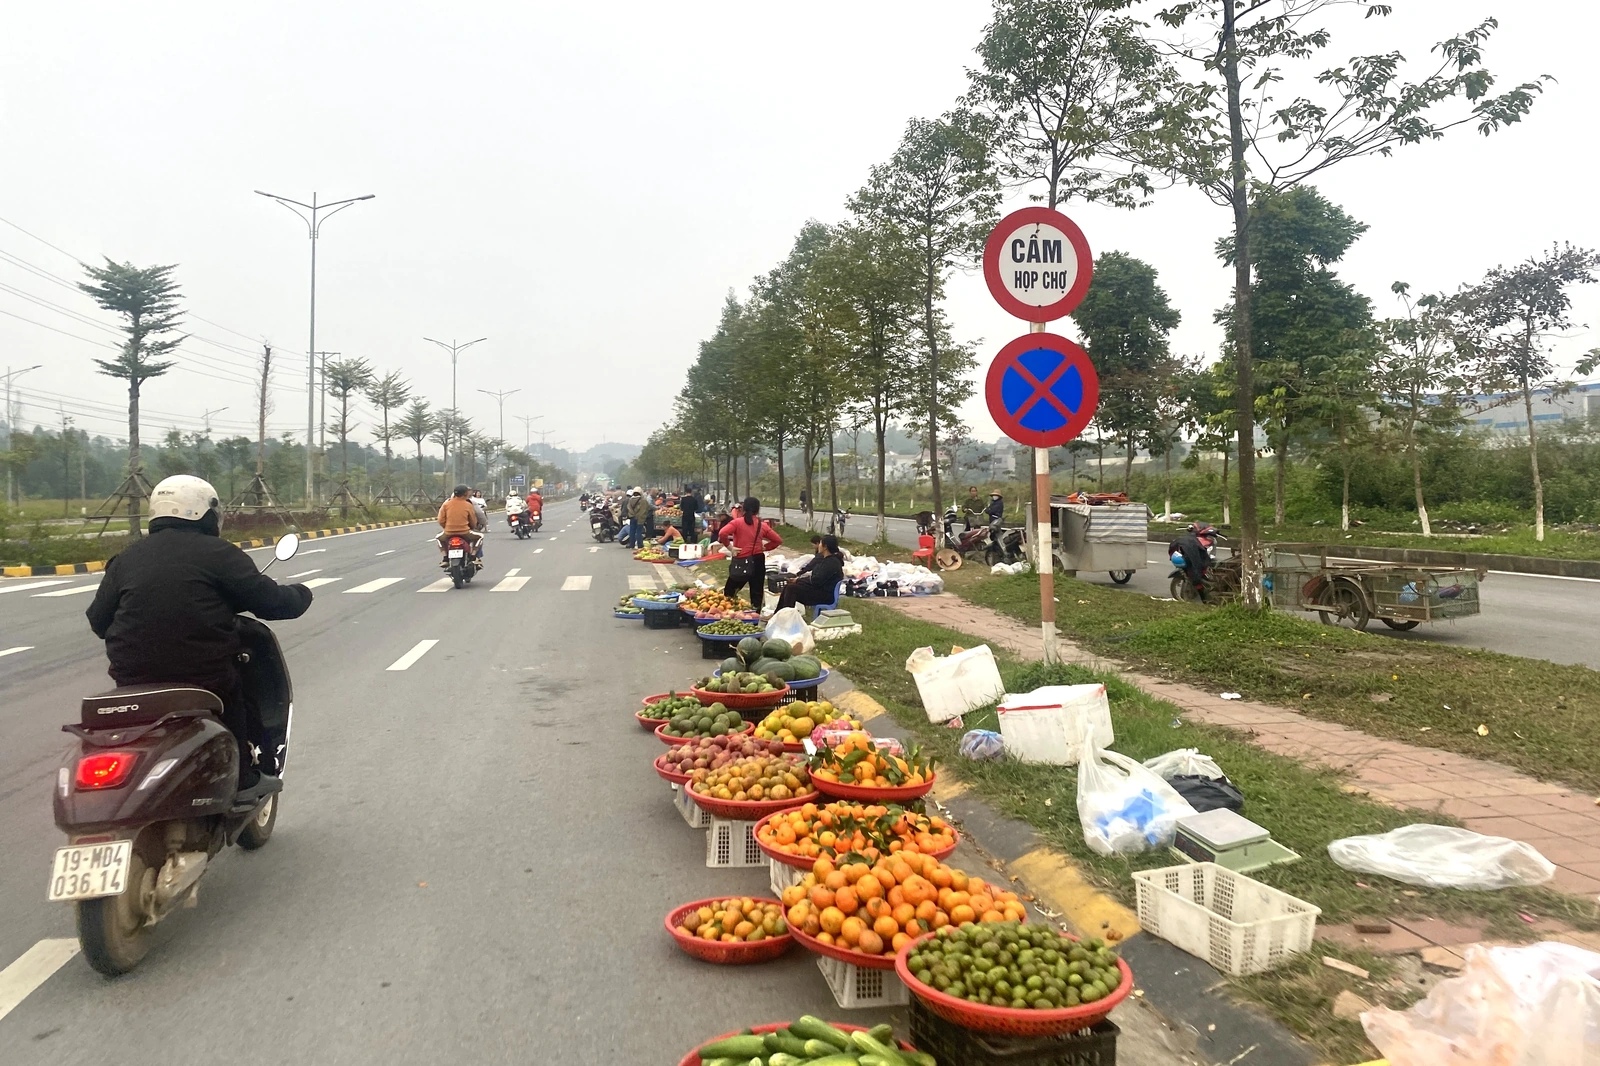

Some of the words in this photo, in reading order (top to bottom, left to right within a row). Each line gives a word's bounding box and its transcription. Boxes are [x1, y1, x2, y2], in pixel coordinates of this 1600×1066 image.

[1011, 229, 1062, 263] CẤM
[1014, 270, 1039, 292] HỌP
[1042, 270, 1067, 294] CHỢ
